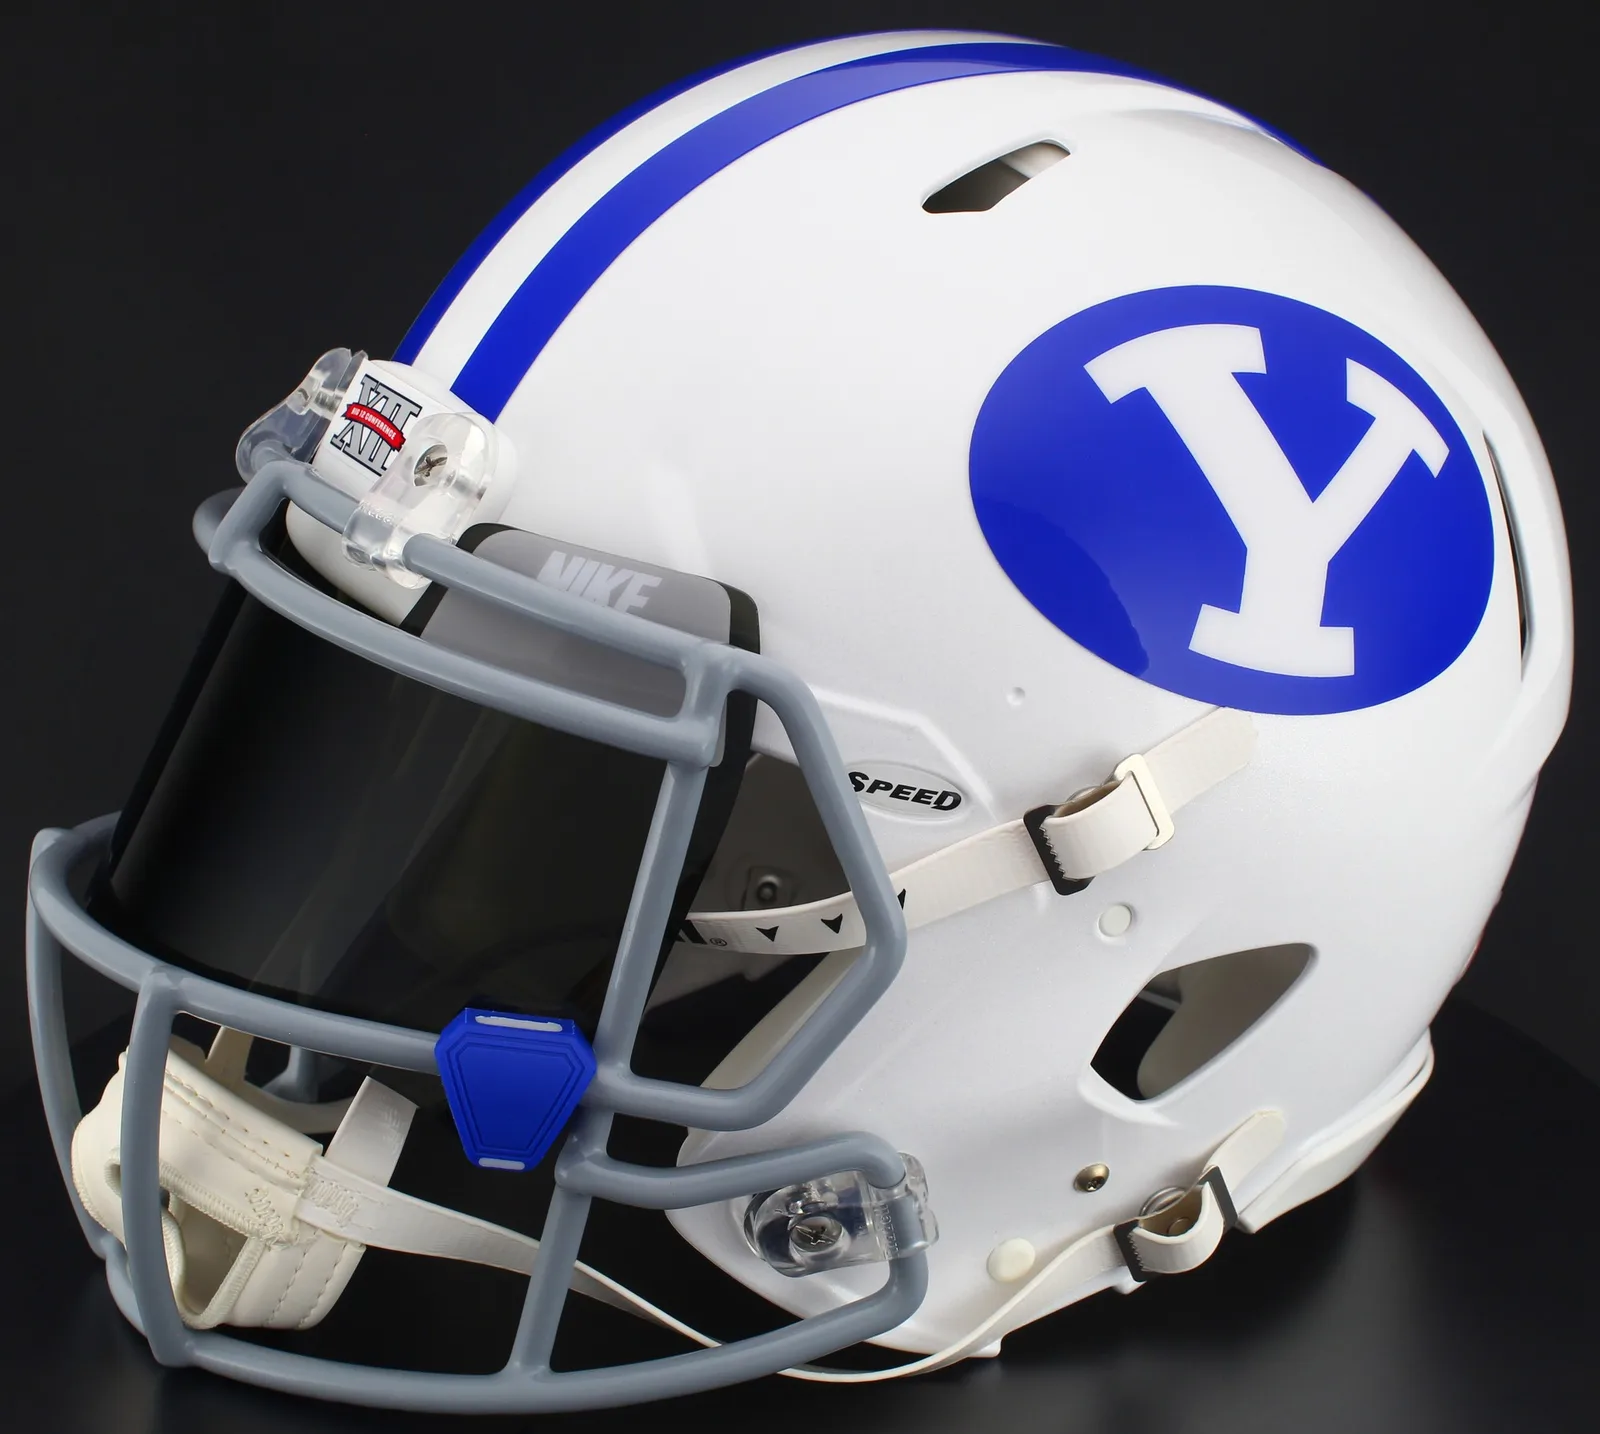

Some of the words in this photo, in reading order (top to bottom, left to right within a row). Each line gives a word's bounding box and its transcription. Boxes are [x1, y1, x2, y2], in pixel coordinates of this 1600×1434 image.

[364, 412, 397, 440] CONFERENCE
[1083, 323, 1450, 678] Y
[536, 550, 663, 613] NIKE
[848, 771, 962, 811] SPEED
